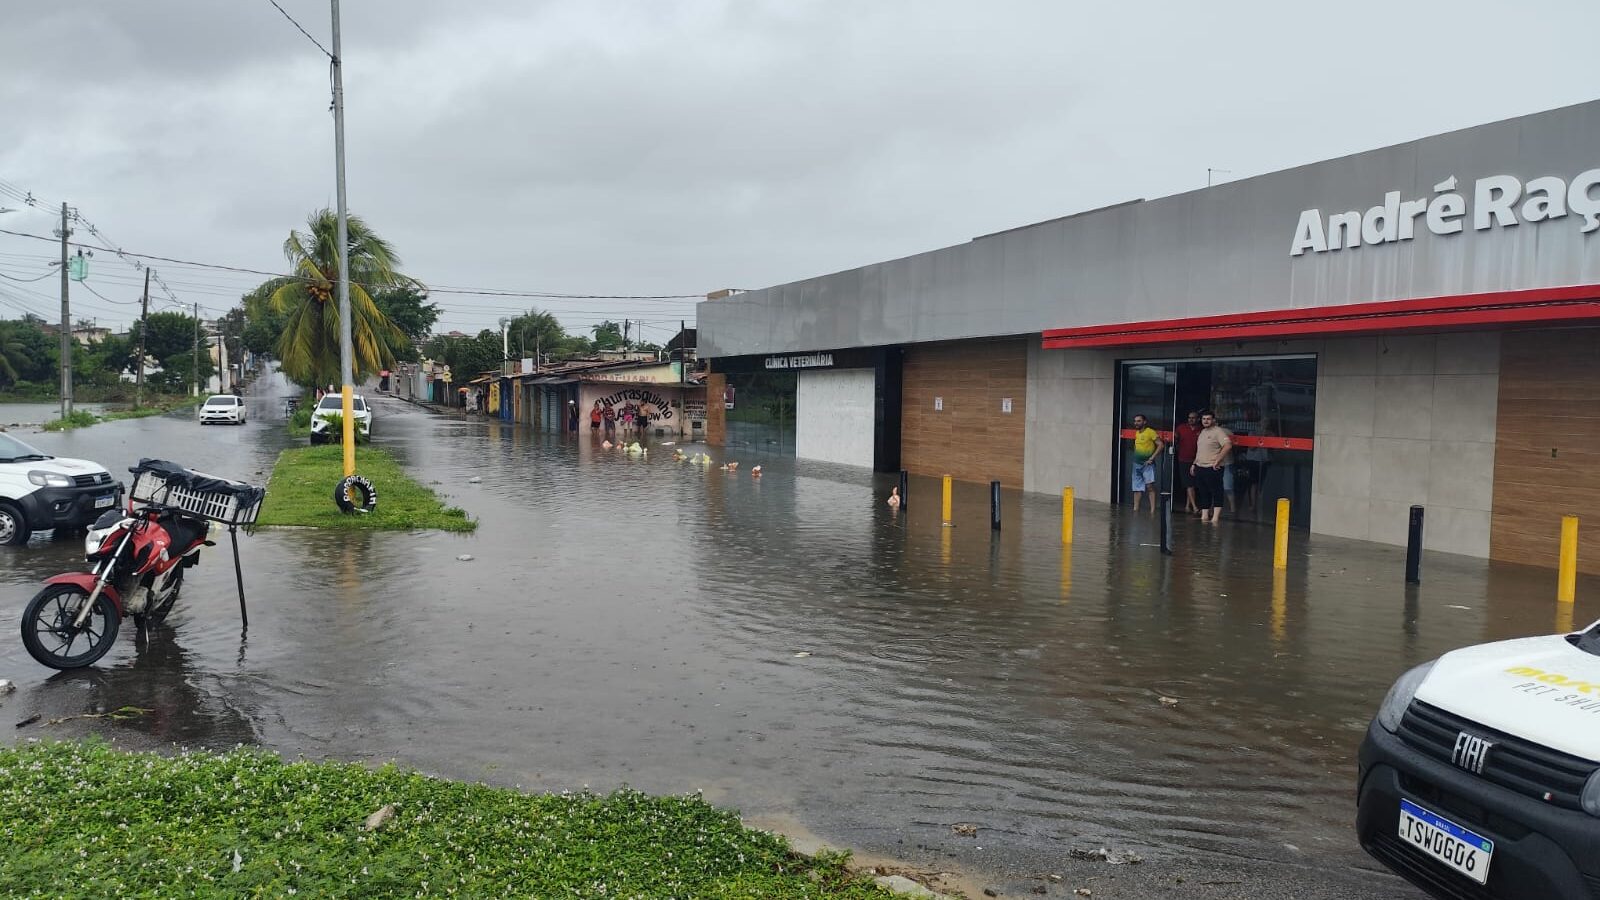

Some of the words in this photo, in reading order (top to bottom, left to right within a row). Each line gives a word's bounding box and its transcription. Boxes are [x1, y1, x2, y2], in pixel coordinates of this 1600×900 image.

[1290, 175, 1467, 257] André
[1473, 168, 1600, 233] Raç
[765, 355, 789, 369] CLÍNICA
[789, 352, 834, 368] VETERINÁRIA
[1512, 682, 1560, 696] PET
[1451, 731, 1493, 775] FIAT
